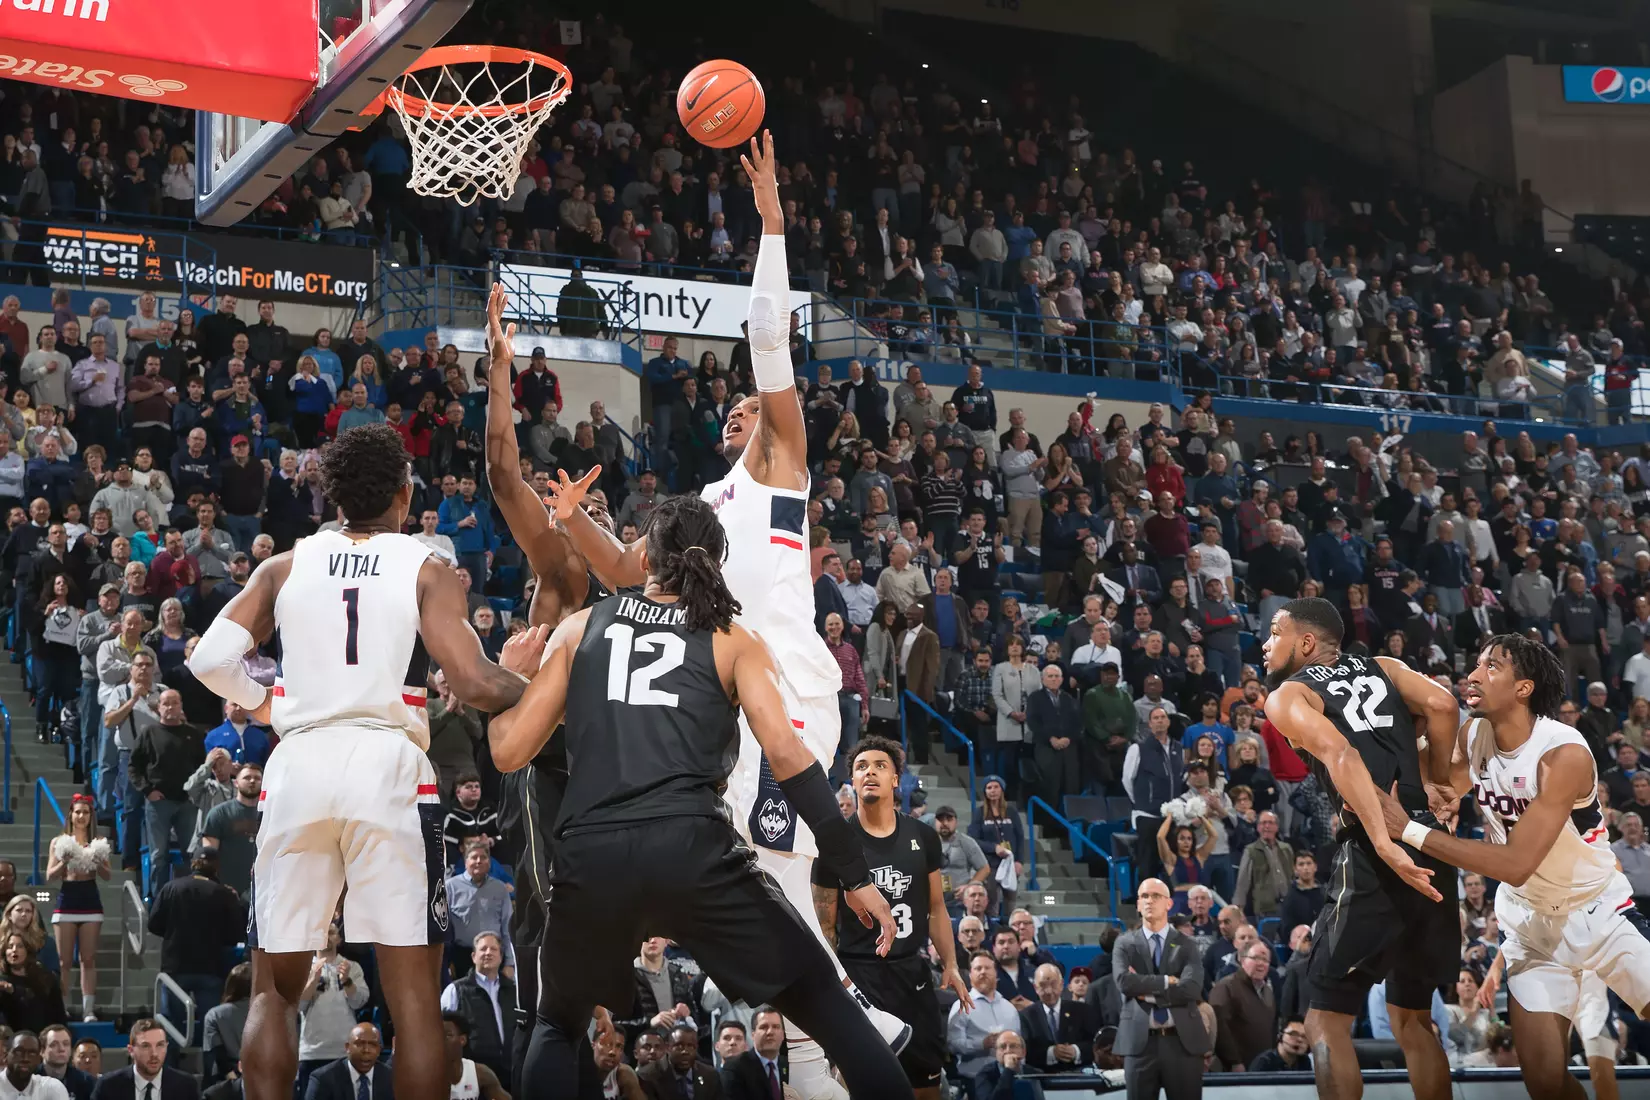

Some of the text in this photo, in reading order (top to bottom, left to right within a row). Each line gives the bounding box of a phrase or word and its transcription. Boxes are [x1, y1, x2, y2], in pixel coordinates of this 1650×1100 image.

[1630, 77, 1650, 99] p
[43, 238, 138, 265] WATCH
[47, 260, 74, 275] OR
[175, 260, 368, 303] WatchForMeCT.org
[1379, 413, 1412, 434] 117
[329, 552, 380, 579] VITAL
[342, 587, 360, 666] 1
[615, 596, 688, 626] INGRAM
[603, 622, 687, 708] 12
[1326, 675, 1394, 733] 22
[869, 864, 913, 900] UCF
[881, 902, 913, 939] 3
